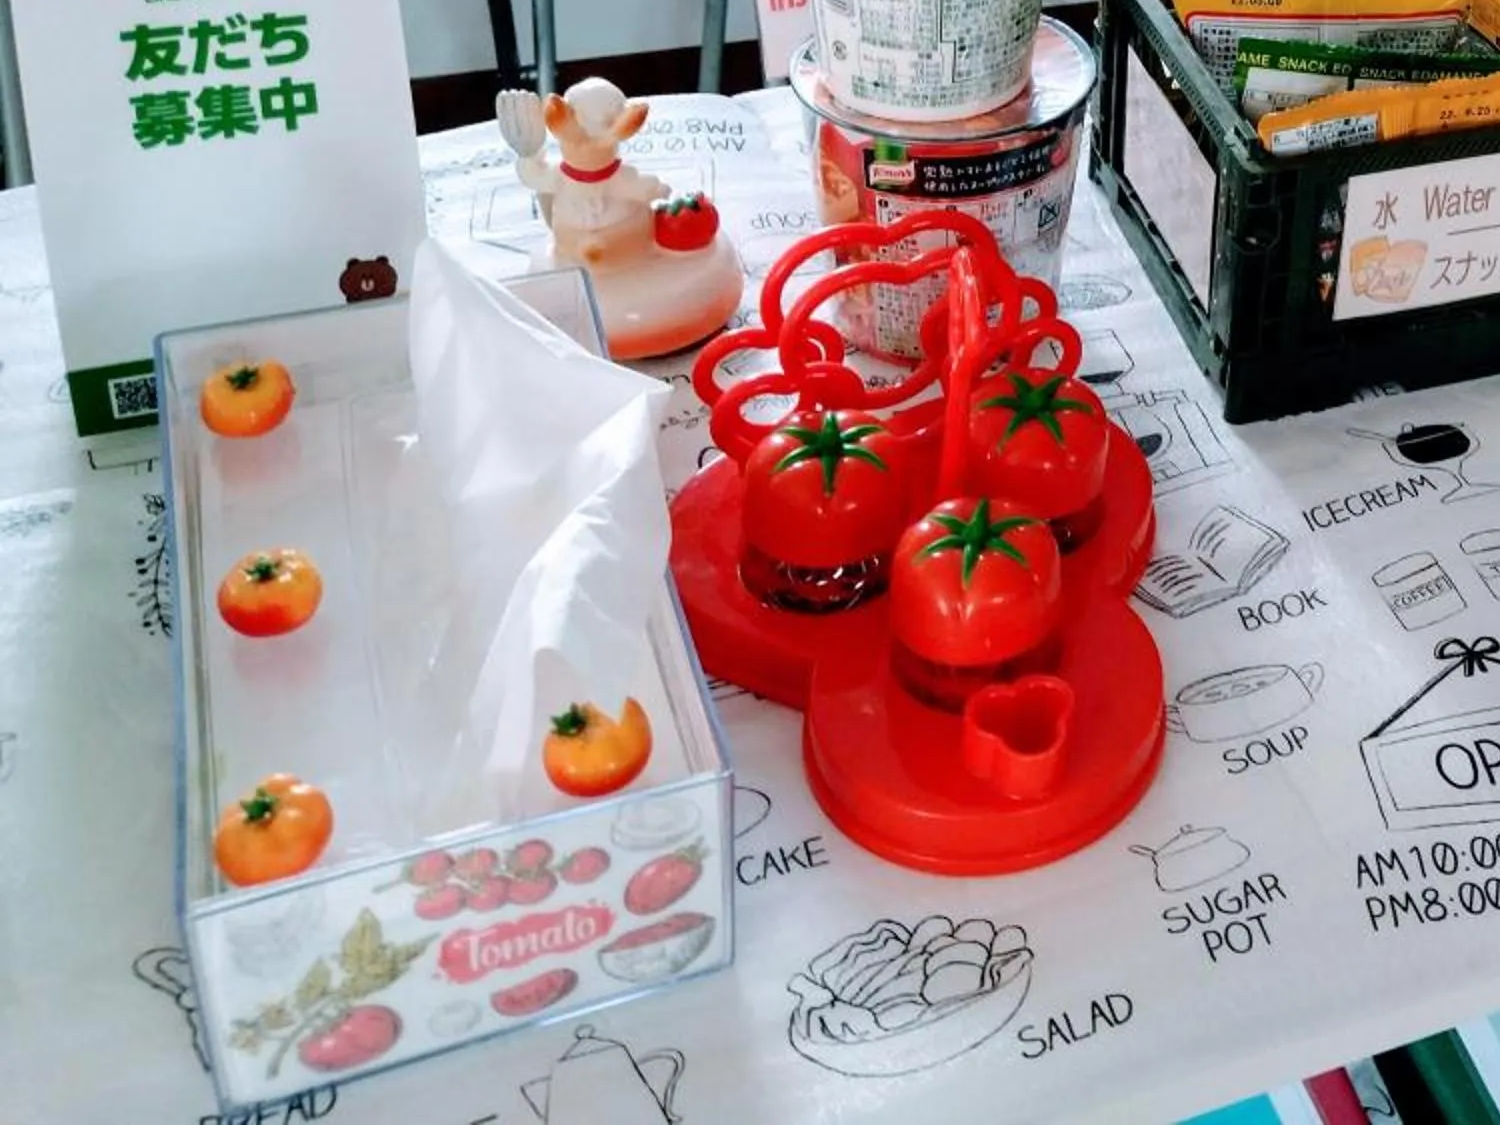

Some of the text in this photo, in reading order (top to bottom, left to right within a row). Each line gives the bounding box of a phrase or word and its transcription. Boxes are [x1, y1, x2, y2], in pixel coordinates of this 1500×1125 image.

[119, 11, 311, 82] 友だち
[1279, 56, 1328, 73] SNACK
[128, 77, 319, 149] 募集中
[1373, 194, 1398, 230] 水
[1423, 183, 1496, 222] Water
[1301, 474, 1438, 533] ICECREAM
[1238, 588, 1329, 633] BOOK
[1221, 725, 1311, 776] SOUP
[734, 835, 831, 887] CAKE
[1162, 873, 1288, 935] SUGAR
[462, 905, 599, 973] Tomato
[1201, 911, 1275, 963] POT
[1016, 992, 1135, 1061] SALAD
